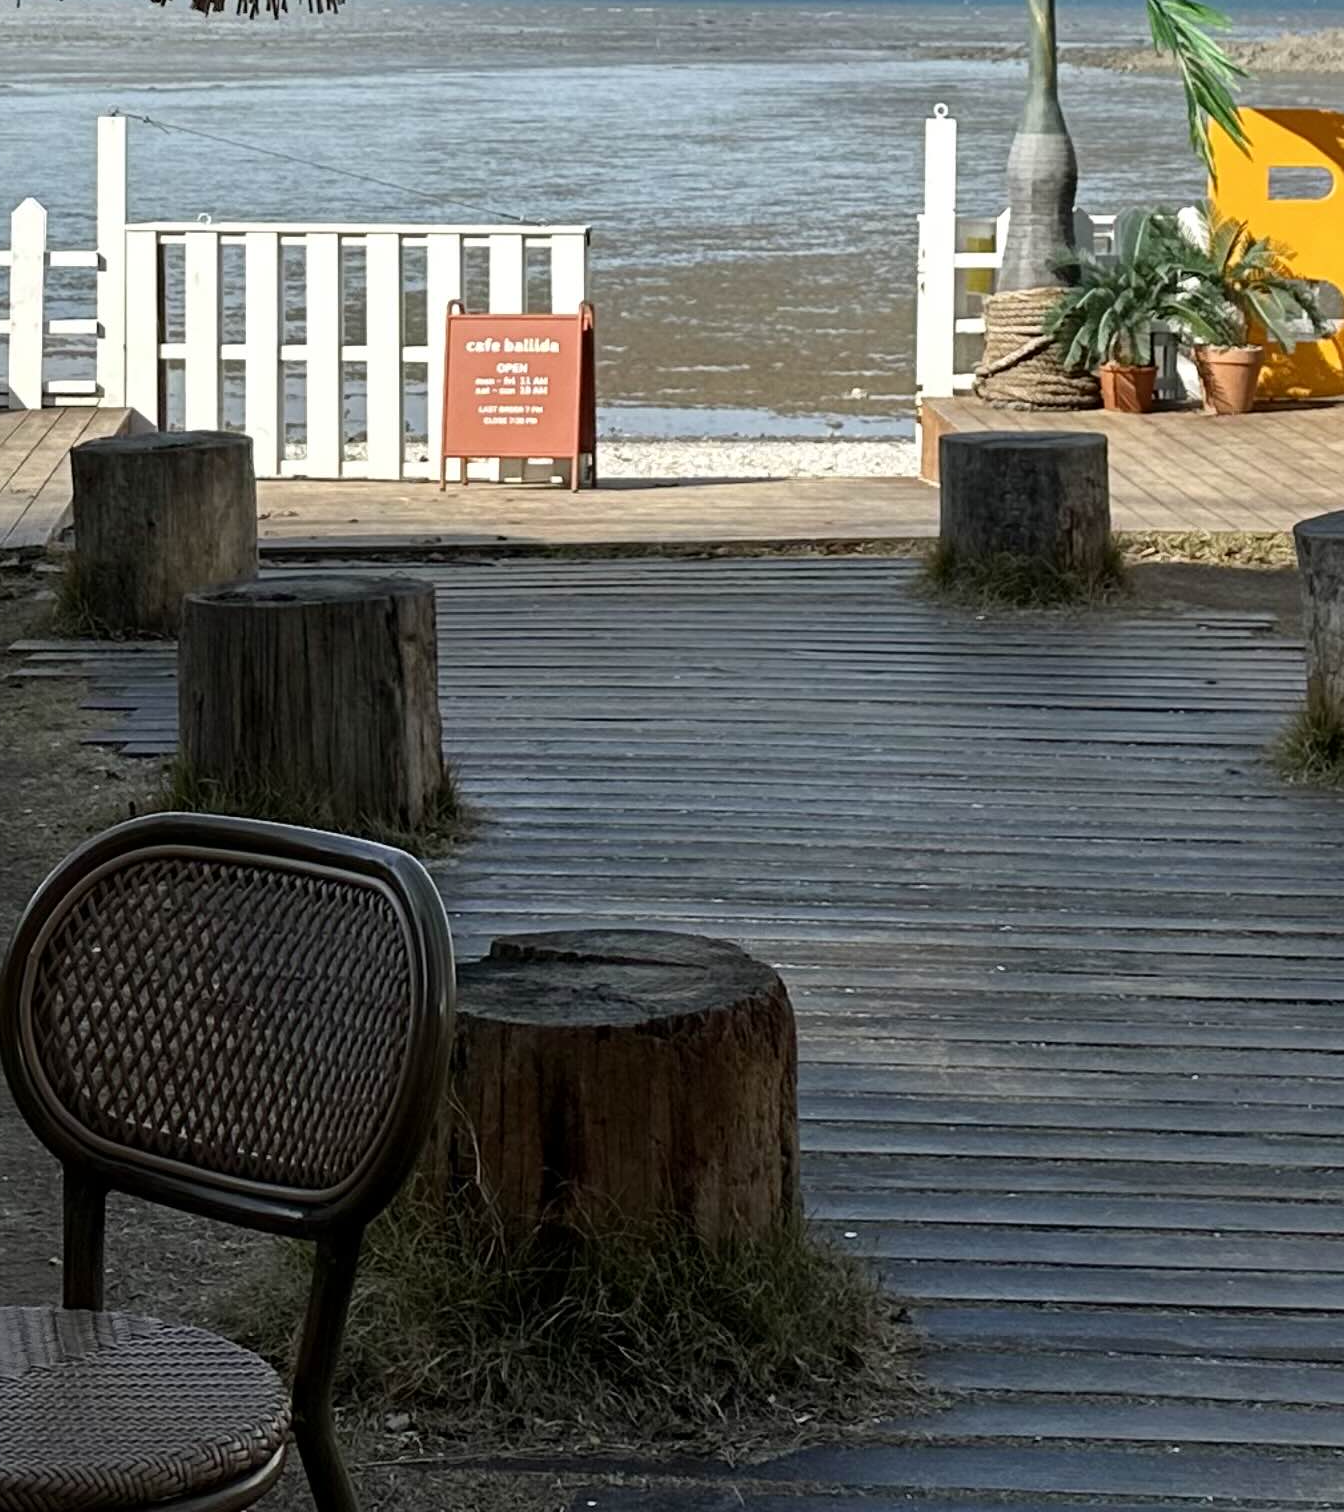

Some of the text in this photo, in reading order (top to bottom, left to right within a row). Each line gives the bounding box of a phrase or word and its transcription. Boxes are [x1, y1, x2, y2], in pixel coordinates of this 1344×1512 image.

[465, 337, 560, 353] cafe baliida
[496, 362, 529, 374] OPEN
